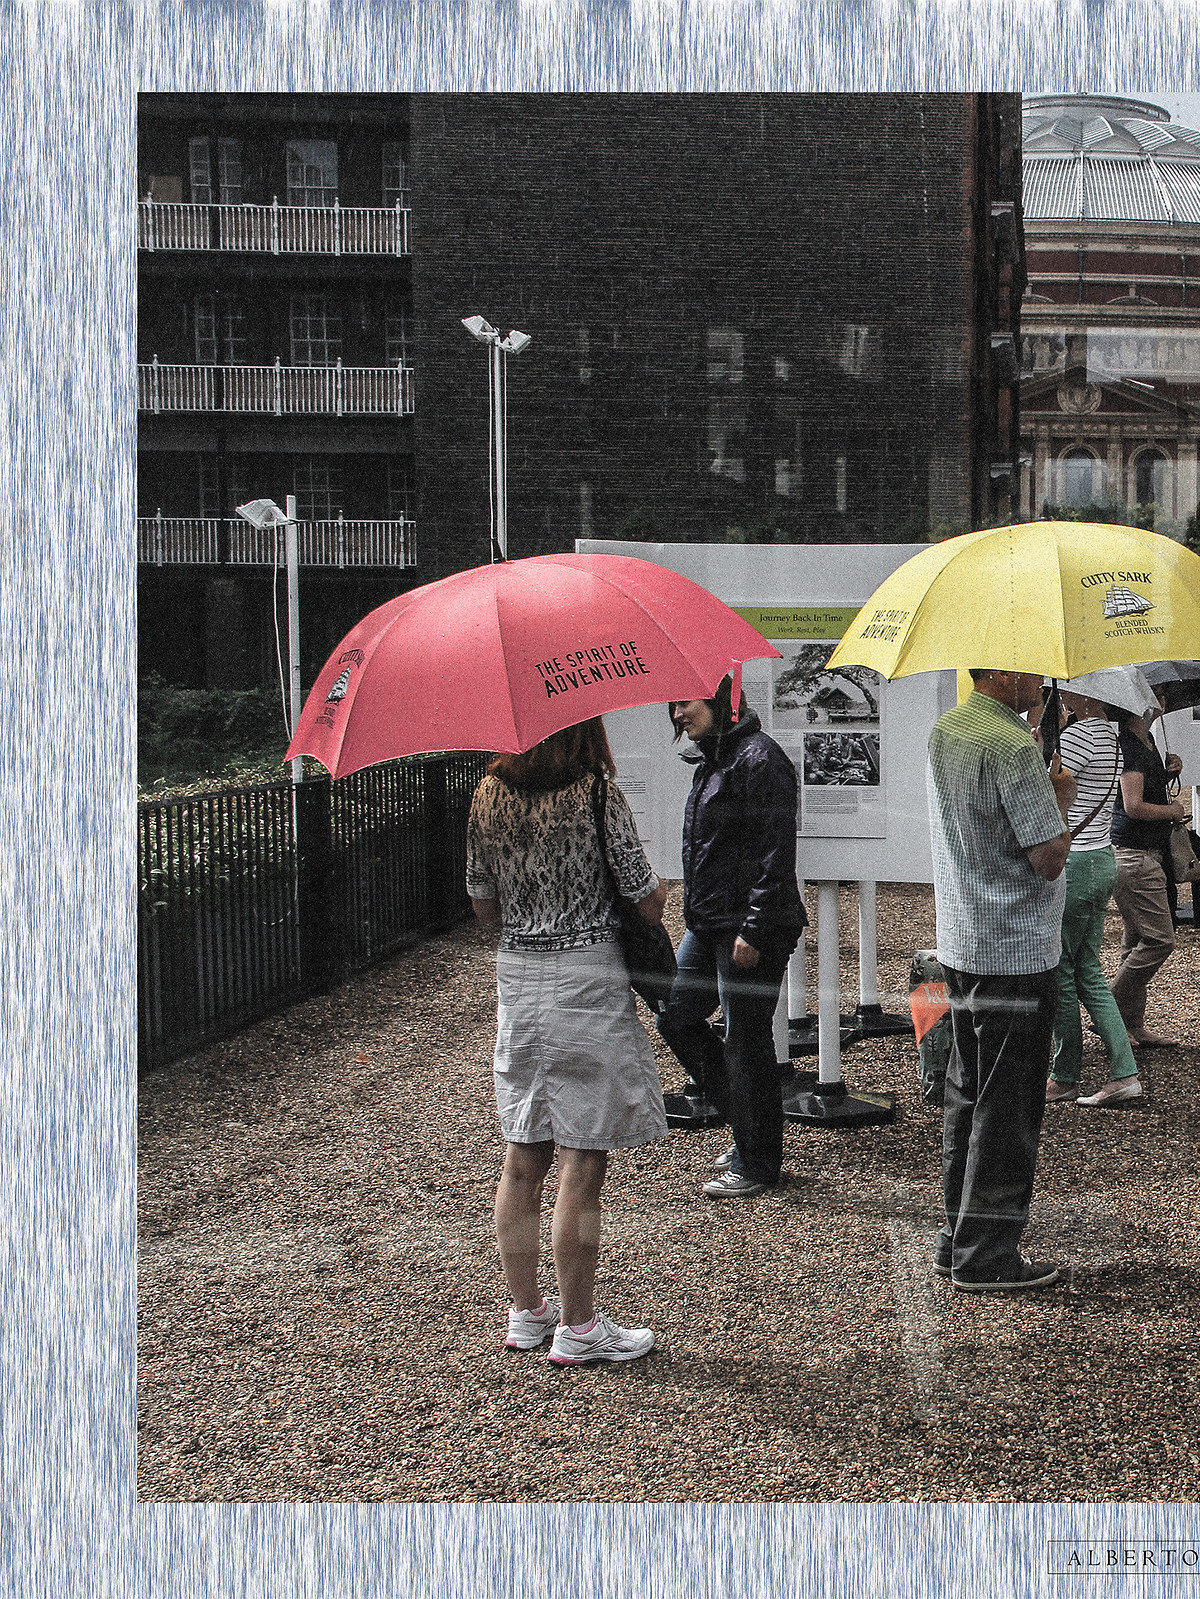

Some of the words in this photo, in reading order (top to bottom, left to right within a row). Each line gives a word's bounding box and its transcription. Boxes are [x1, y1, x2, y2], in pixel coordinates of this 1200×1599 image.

[1080, 572, 1116, 588] CUTTY
[1117, 571, 1152, 584] SARK
[759, 614, 790, 624] Journey
[792, 613, 812, 622] Back
[814, 614, 822, 622] In
[823, 614, 843, 622] Time
[1115, 619, 1149, 628] BLENDED
[1104, 628, 1134, 639] SCOTCH
[1134, 627, 1166, 635] WHISKY
[534, 658, 565, 678] THE
[566, 645, 616, 667] SPIRIT
[619, 641, 638, 656] OF
[544, 657, 651, 698] ADVENTURE
